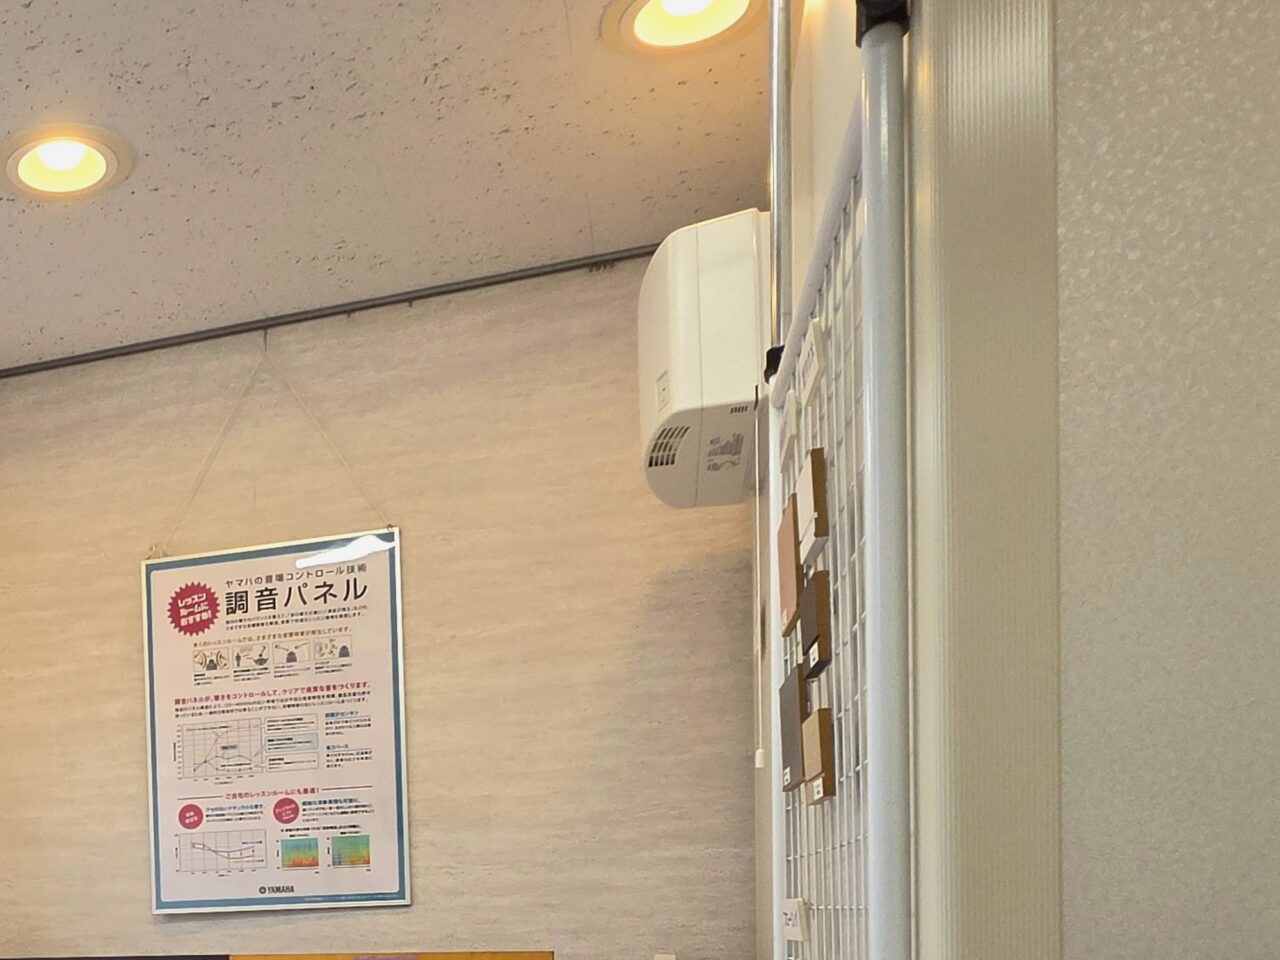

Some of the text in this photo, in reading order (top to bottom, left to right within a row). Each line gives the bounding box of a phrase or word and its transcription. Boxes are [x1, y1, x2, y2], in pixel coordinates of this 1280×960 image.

[225, 563, 367, 588] ヤマハの音場コントロール技術
[178, 592, 207, 608] レッスン
[225, 577, 368, 616] 調音パネル
[267, 885, 295, 894] YAMAHA
